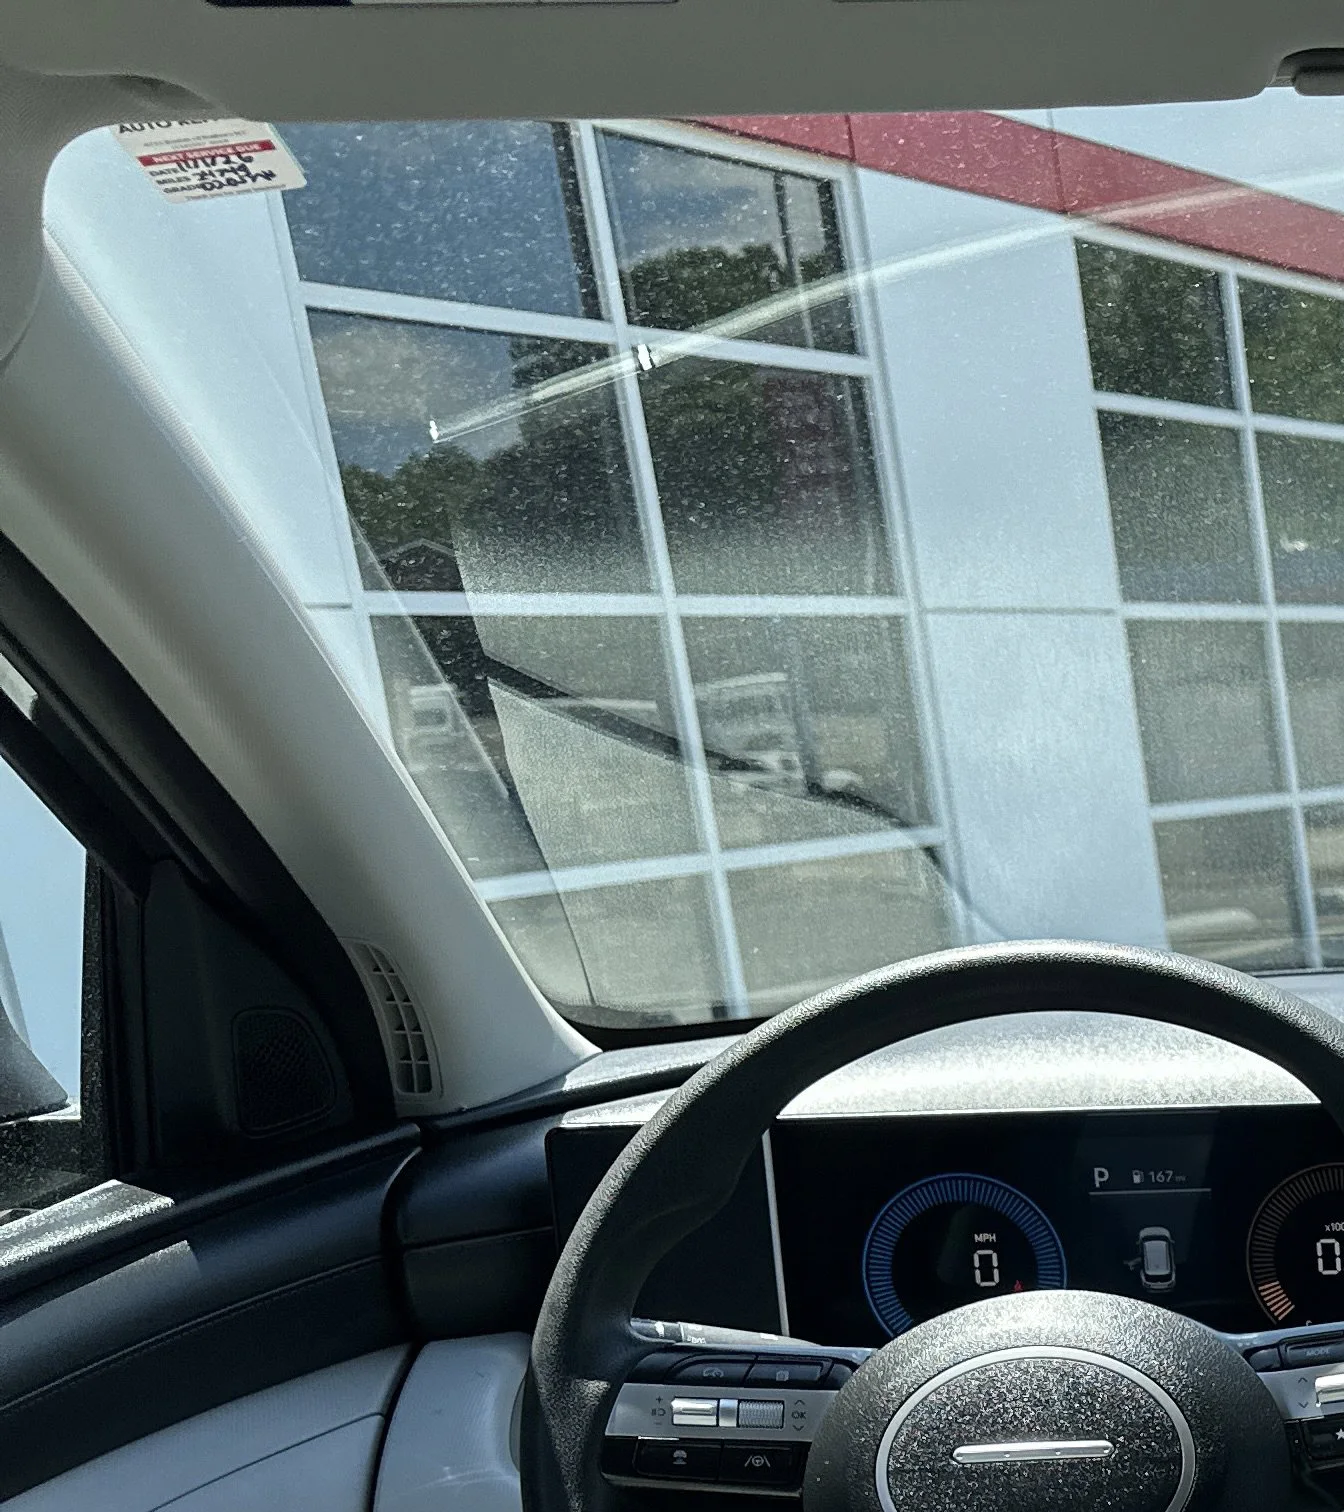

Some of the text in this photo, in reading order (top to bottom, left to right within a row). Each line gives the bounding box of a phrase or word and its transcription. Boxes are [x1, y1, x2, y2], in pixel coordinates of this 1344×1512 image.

[185, 146, 234, 159] SERVICE
[1093, 1167, 1110, 1188] P
[1148, 1170, 1174, 1184] 167
[974, 1233, 997, 1243] MPH
[973, 1249, 1000, 1287] 0
